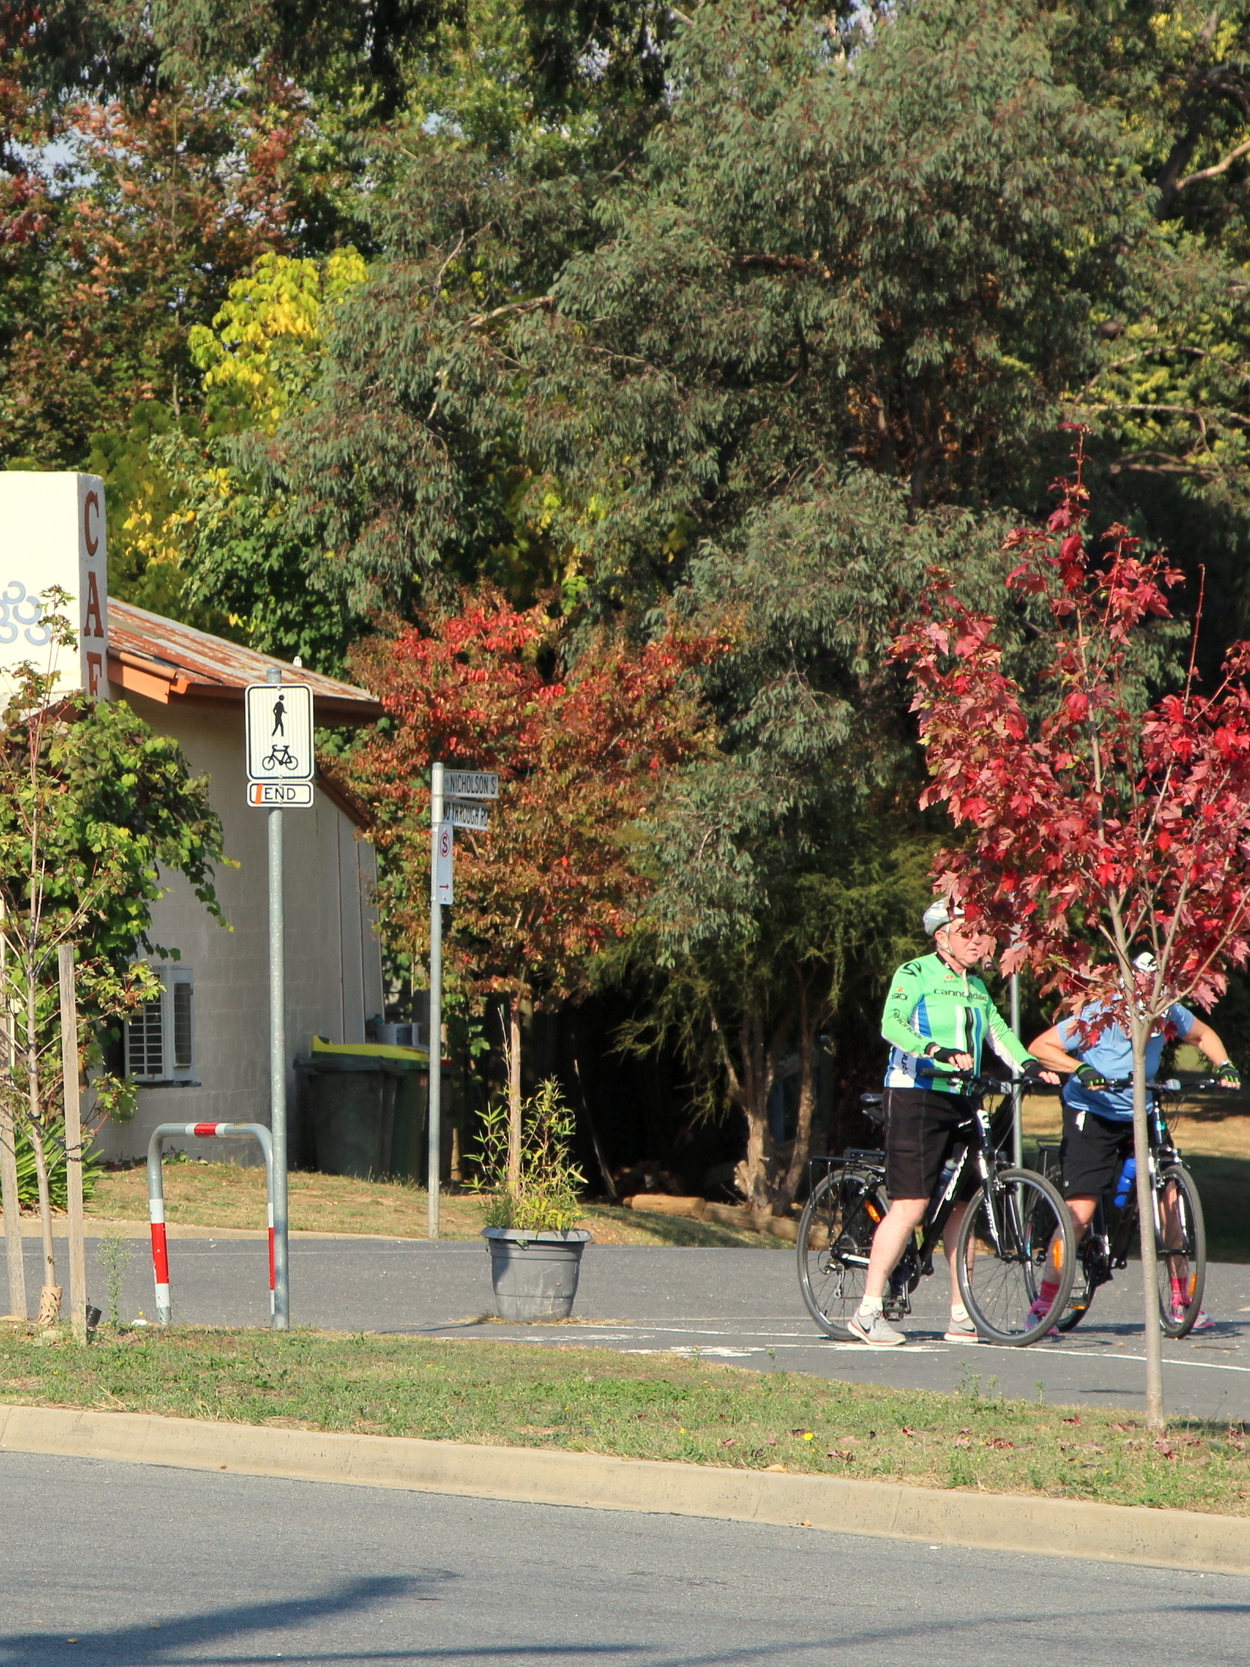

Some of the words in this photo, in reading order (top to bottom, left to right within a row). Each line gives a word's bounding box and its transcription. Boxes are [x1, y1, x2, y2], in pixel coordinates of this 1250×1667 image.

[264, 787, 296, 800] END
[450, 773, 489, 794] NICHOLSON
[452, 802, 479, 824] THROUGH
